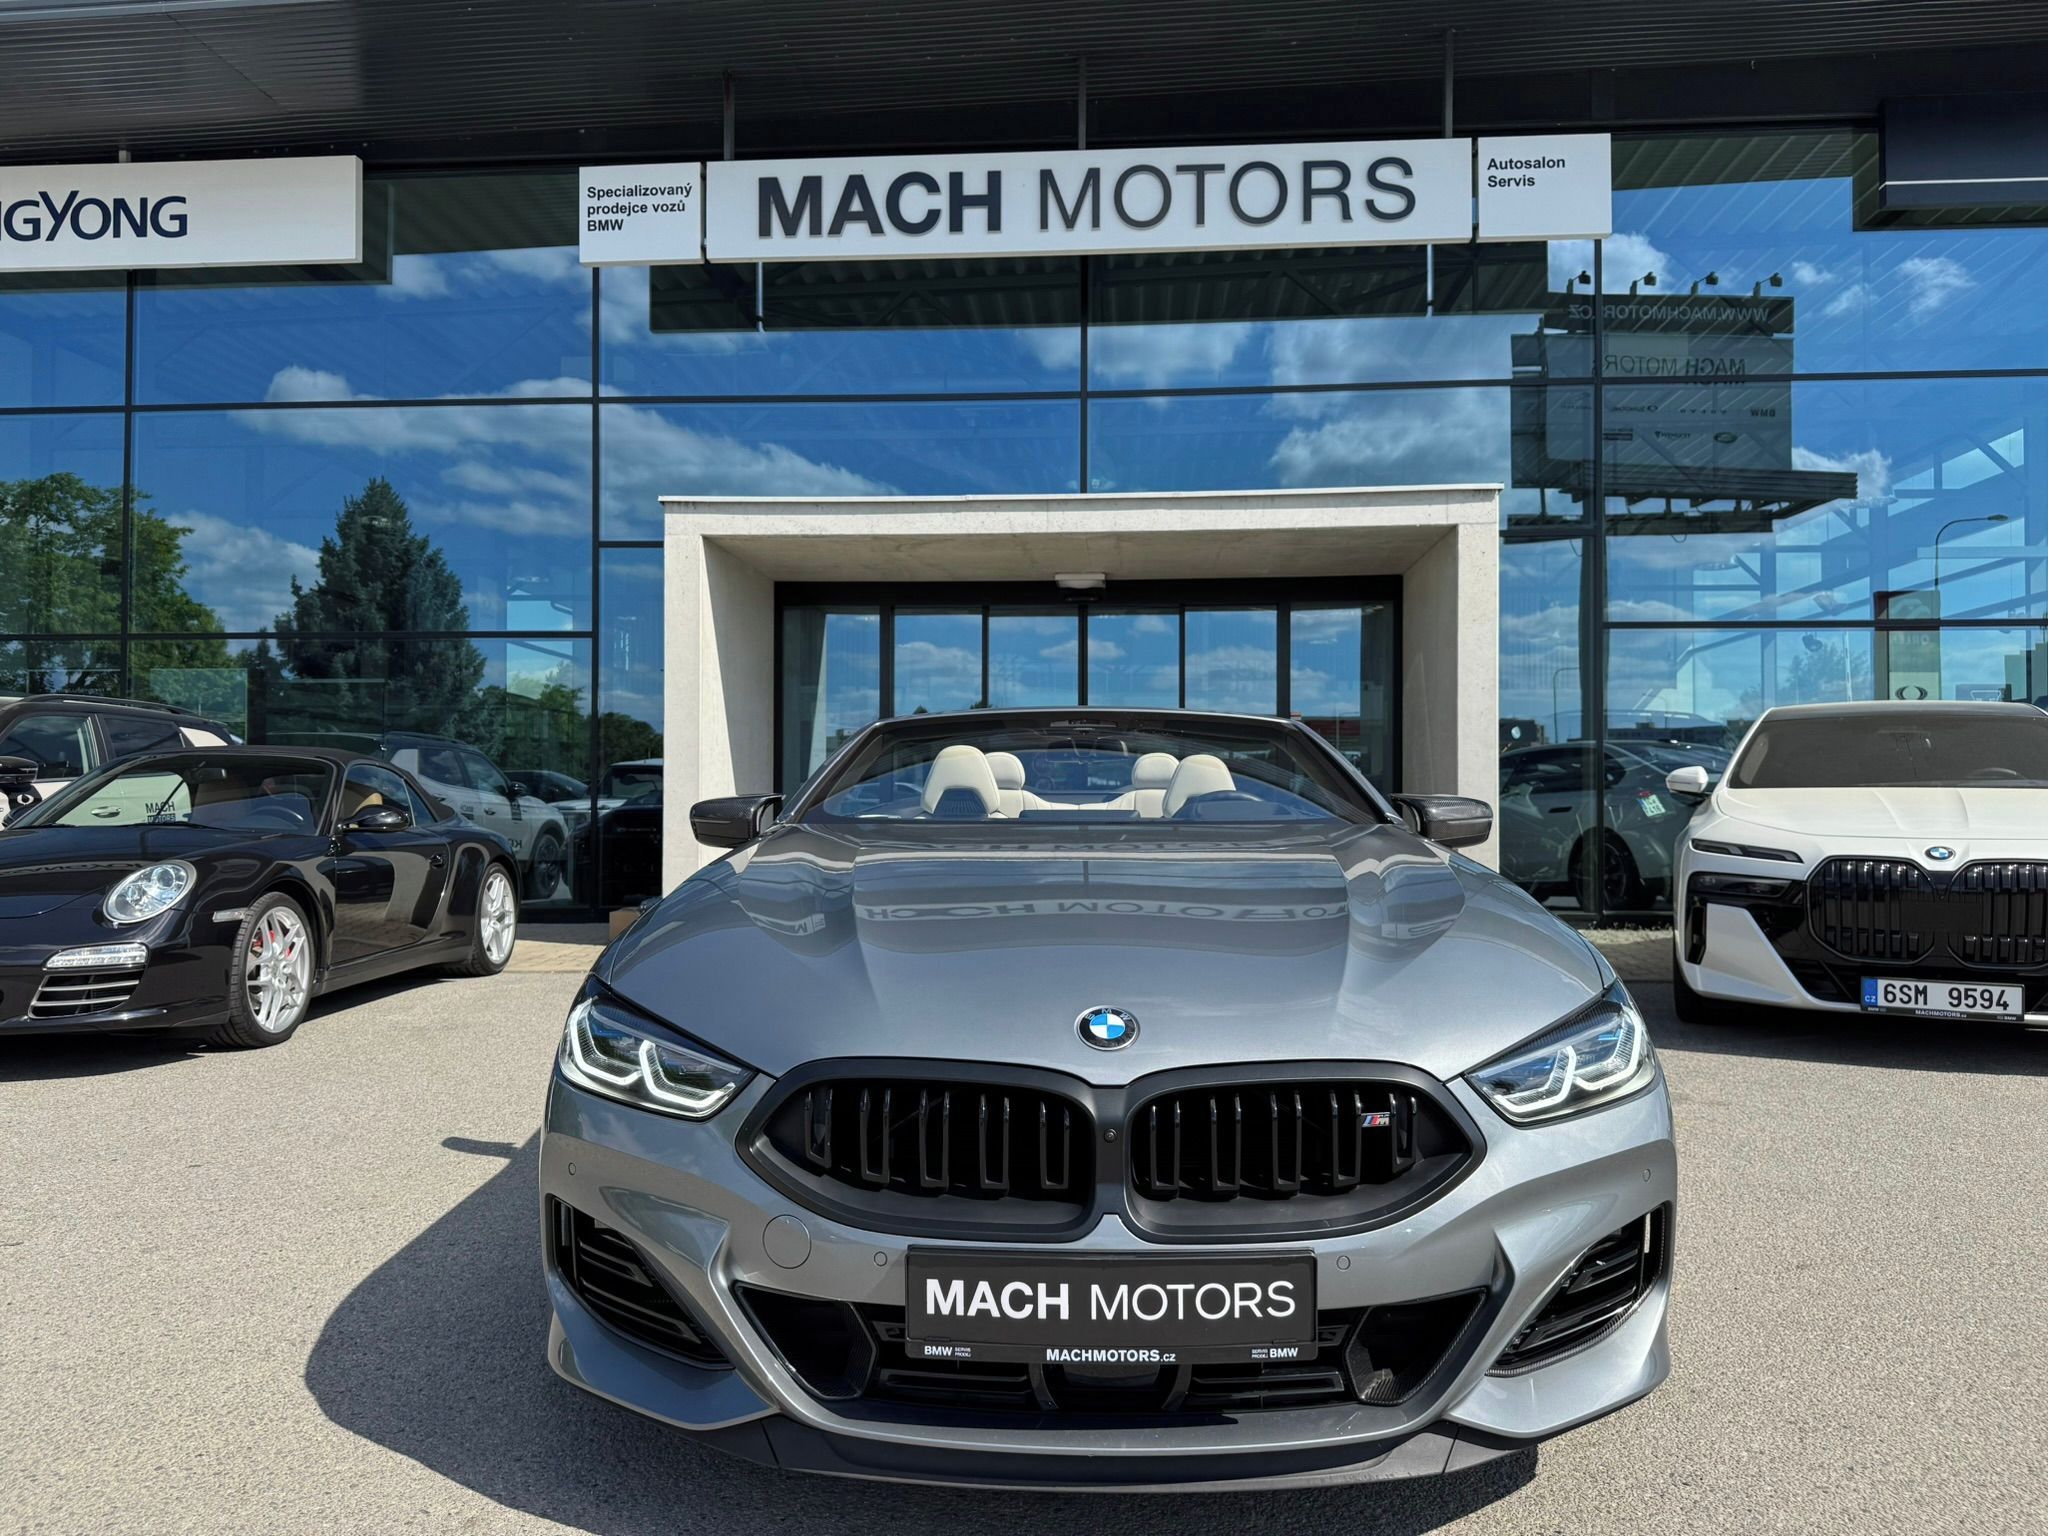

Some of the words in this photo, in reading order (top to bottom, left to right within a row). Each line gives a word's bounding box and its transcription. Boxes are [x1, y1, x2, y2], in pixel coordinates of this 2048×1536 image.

[1487, 157, 1566, 171] Autosalon
[1487, 174, 1536, 188] Servis
[587, 183, 693, 201] Specializovaný
[758, 170, 1003, 239] MACH
[1039, 157, 1417, 232] MOTORS
[0, 190, 188, 242] GYONG
[587, 202, 648, 218] prodejce
[652, 200, 686, 213] vozů
[587, 218, 624, 232] BMW
[1864, 995, 1876, 1003] CZ
[1883, 983, 1928, 1006] 6SM
[1948, 987, 2009, 1011] 9594
[1085, 1007, 1131, 1021] BMW
[926, 1278, 1070, 1321] MACH
[1090, 1280, 1296, 1321] MOTORS
[924, 1345, 953, 1357] BMW
[1269, 1347, 1299, 1358] BMW
